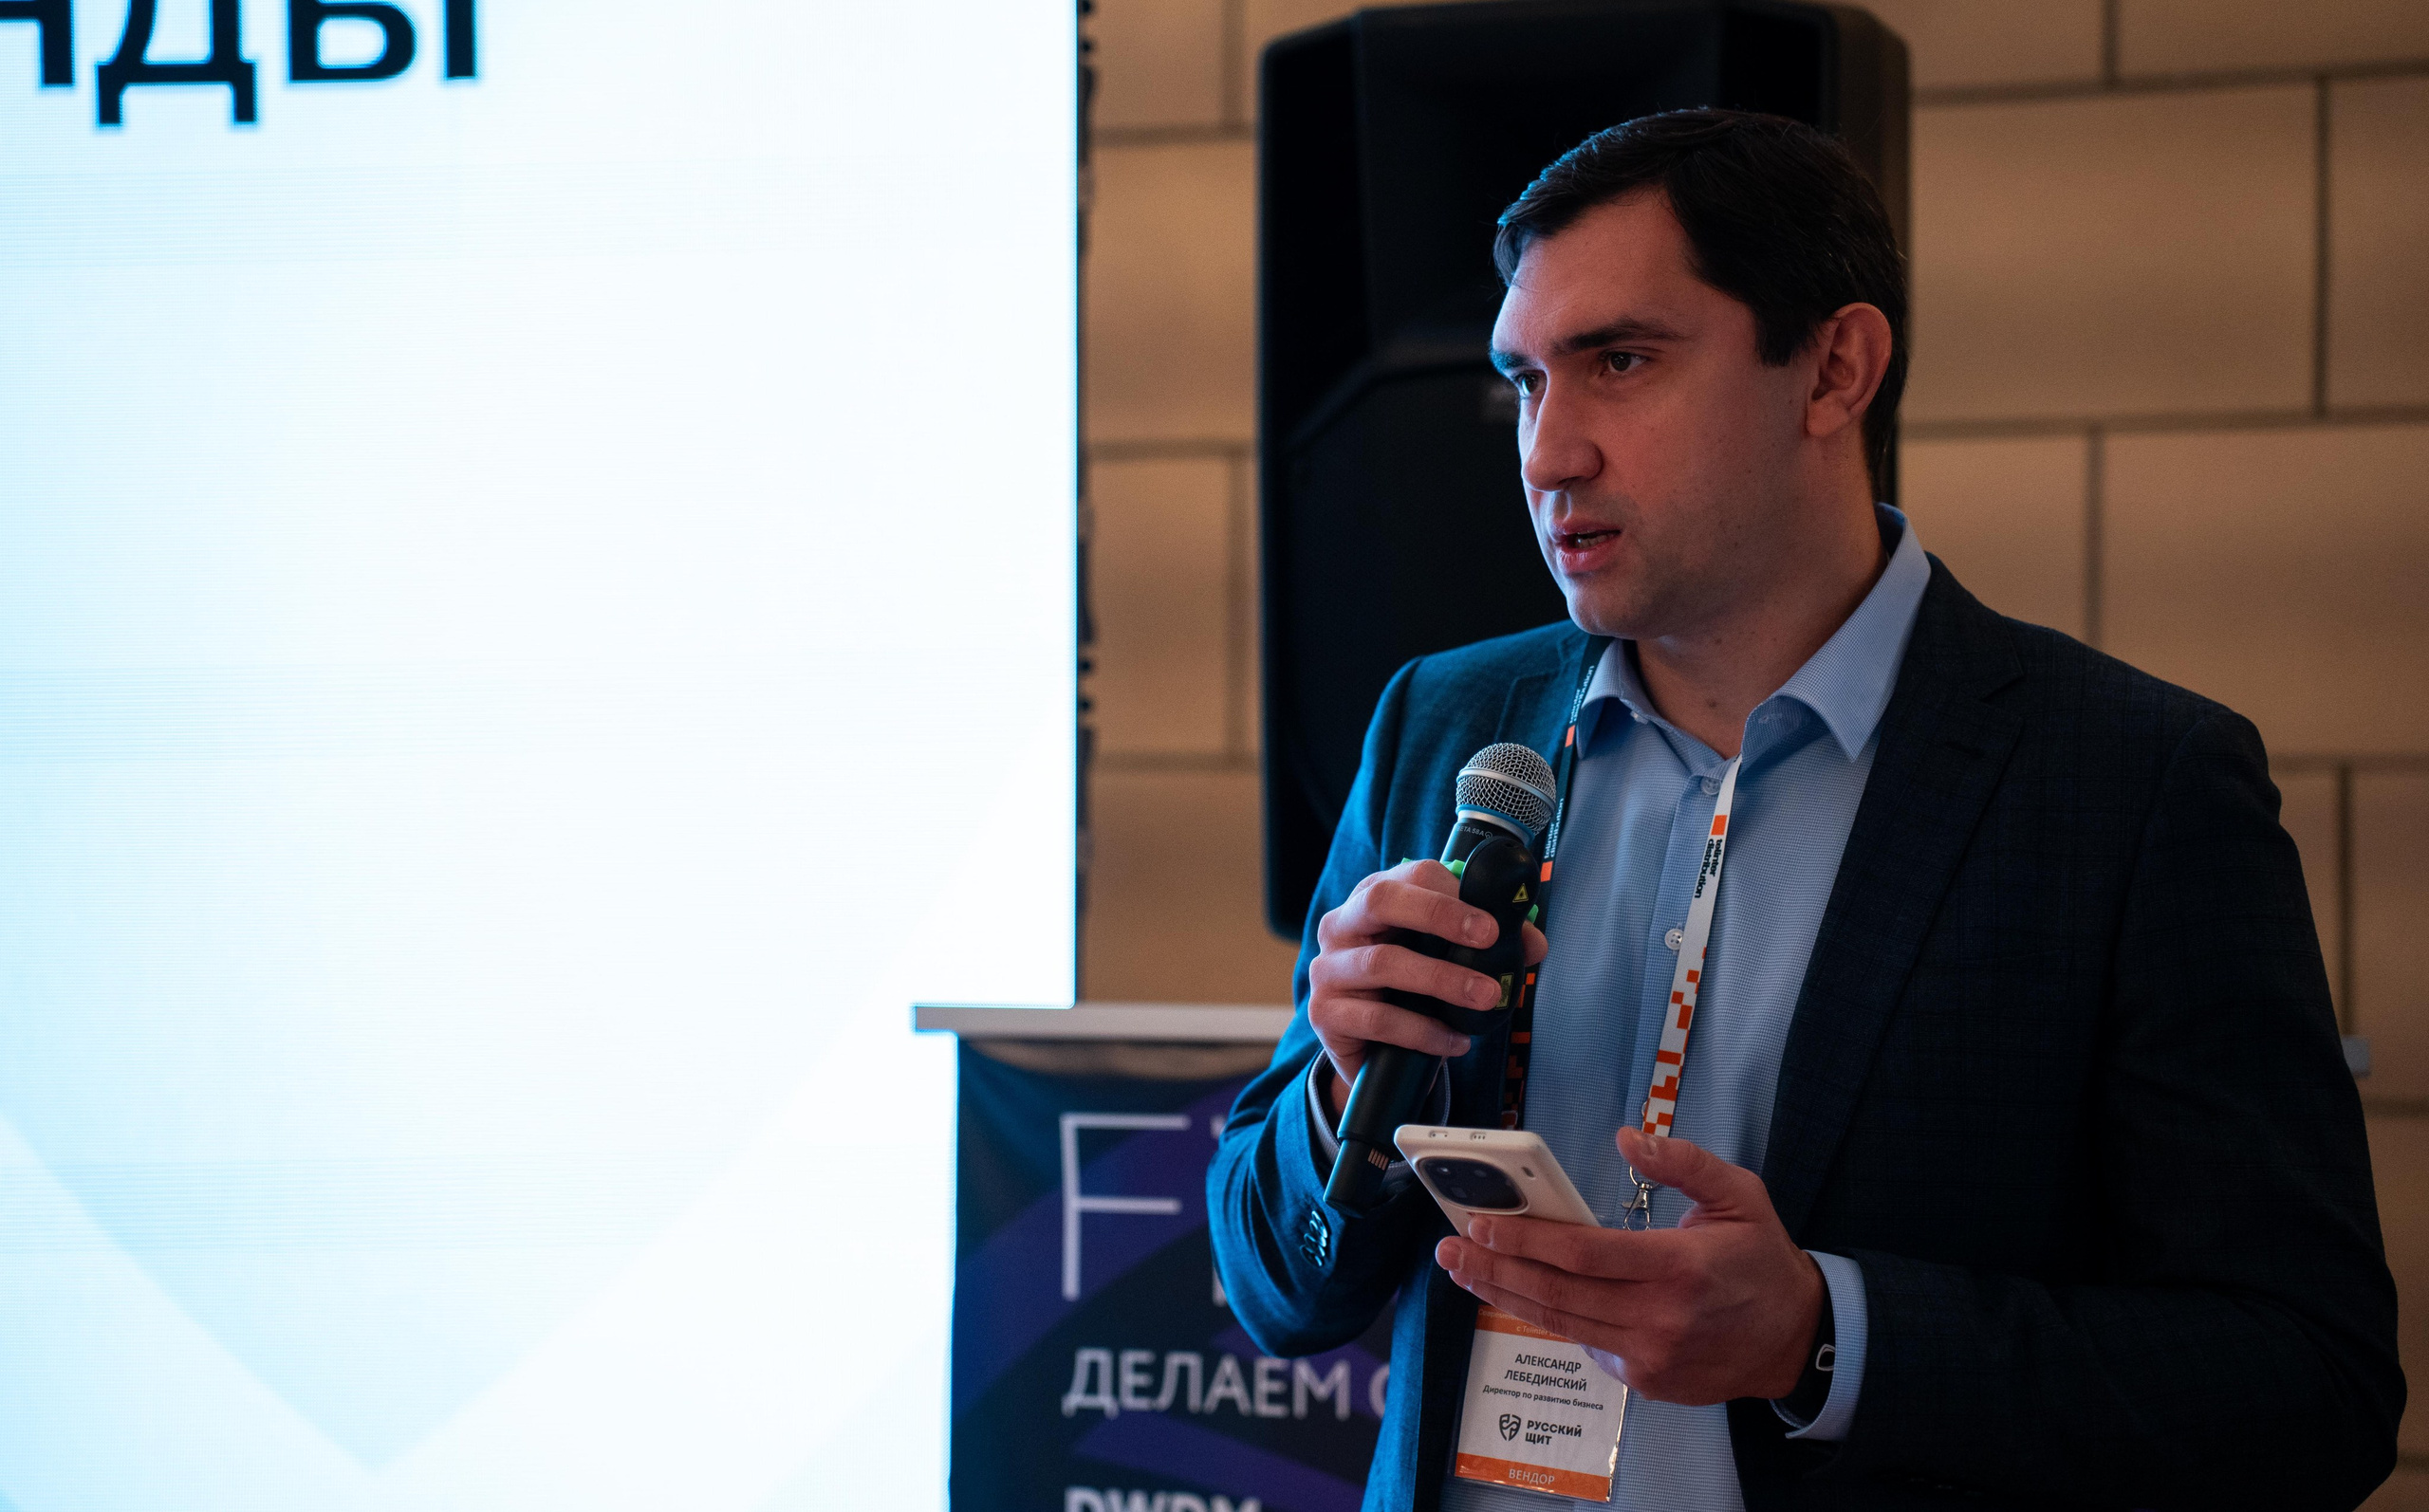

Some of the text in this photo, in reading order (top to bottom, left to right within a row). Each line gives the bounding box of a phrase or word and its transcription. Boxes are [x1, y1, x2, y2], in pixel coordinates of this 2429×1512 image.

[1694, 839, 1715, 898] distribution
[1514, 1354, 1582, 1374] АЛЕКСАНДР
[1060, 1346, 1353, 1422] ДЕЛАЕМ
[1504, 1369, 1587, 1392] ЛЕБЕДИНСКИЙ
[1482, 1385, 1521, 1398] Директор
[1533, 1393, 1571, 1406] развитию
[1572, 1398, 1604, 1411] бизнеса
[1525, 1432, 1552, 1446] ЩИТ
[1527, 1420, 1583, 1437] РУССКИЙ
[1509, 1468, 1555, 1485] ВЕНДОР
